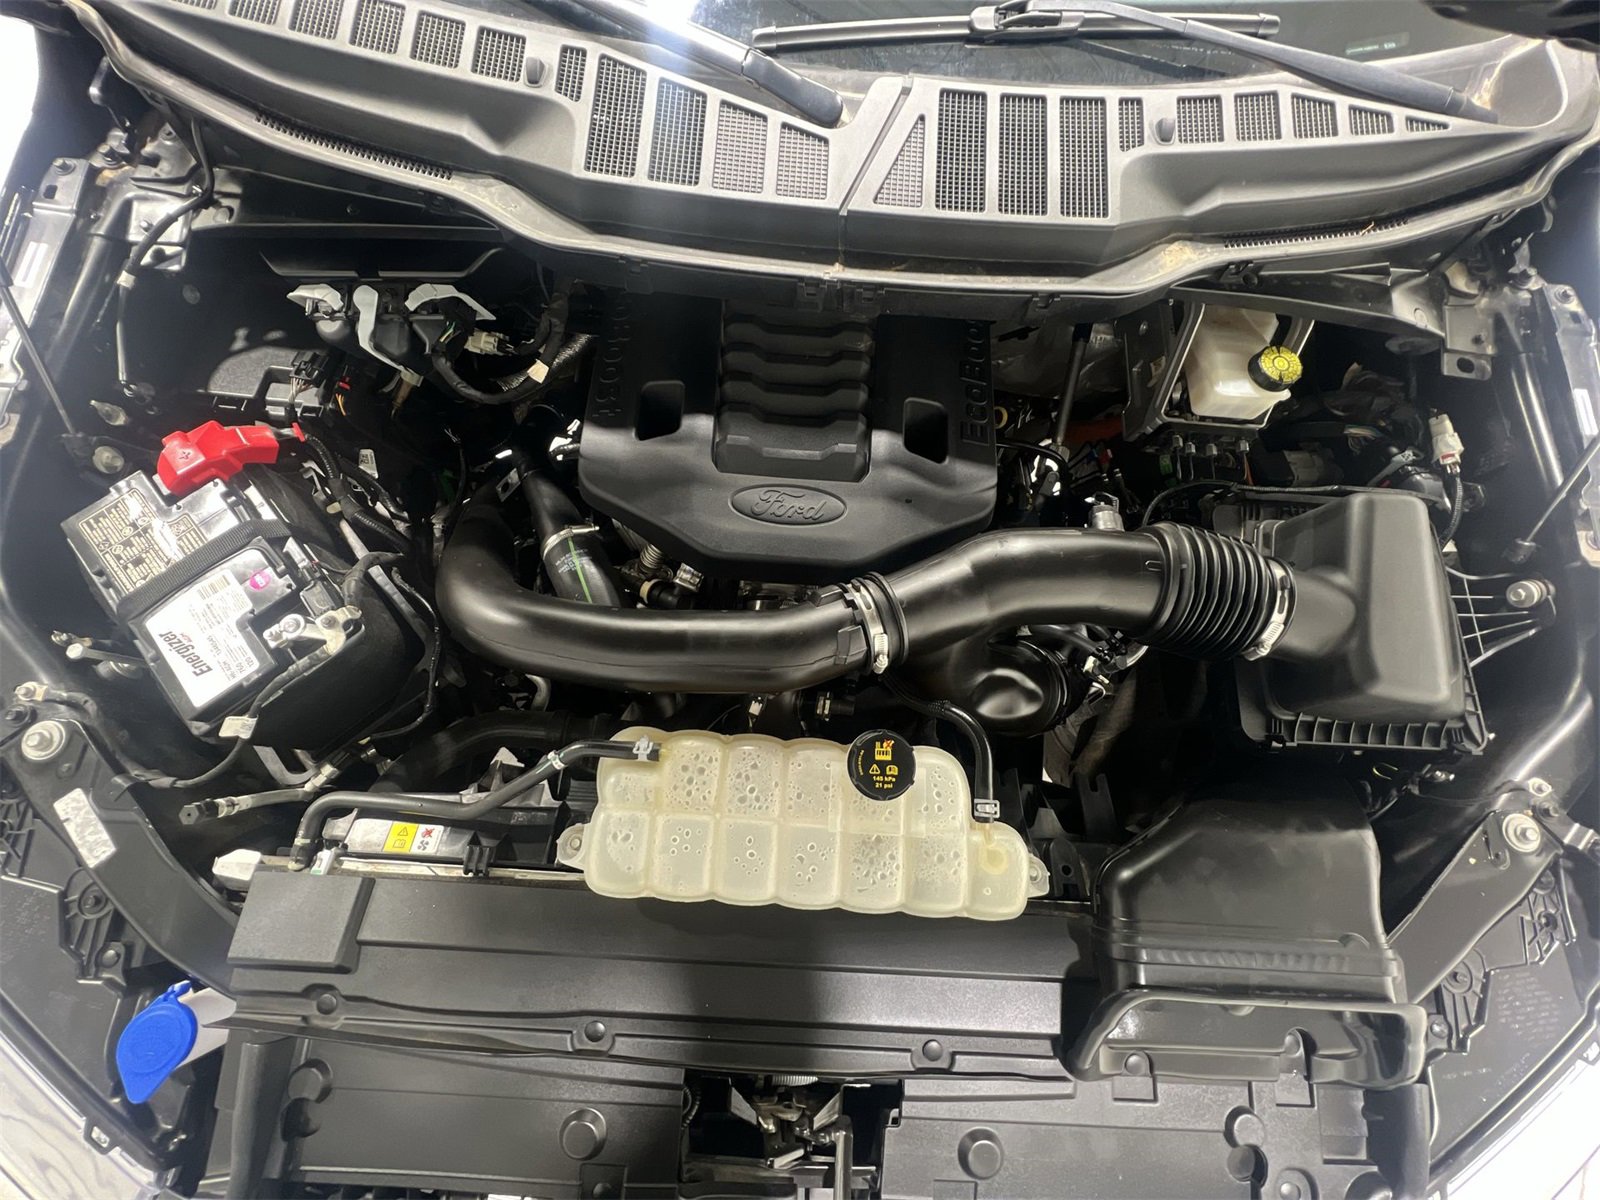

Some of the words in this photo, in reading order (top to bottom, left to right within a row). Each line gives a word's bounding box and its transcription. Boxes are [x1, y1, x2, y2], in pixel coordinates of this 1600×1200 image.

[959, 320, 990, 448] EcoBoo
[750, 489, 827, 520] Ford
[158, 631, 213, 677] Energizer
